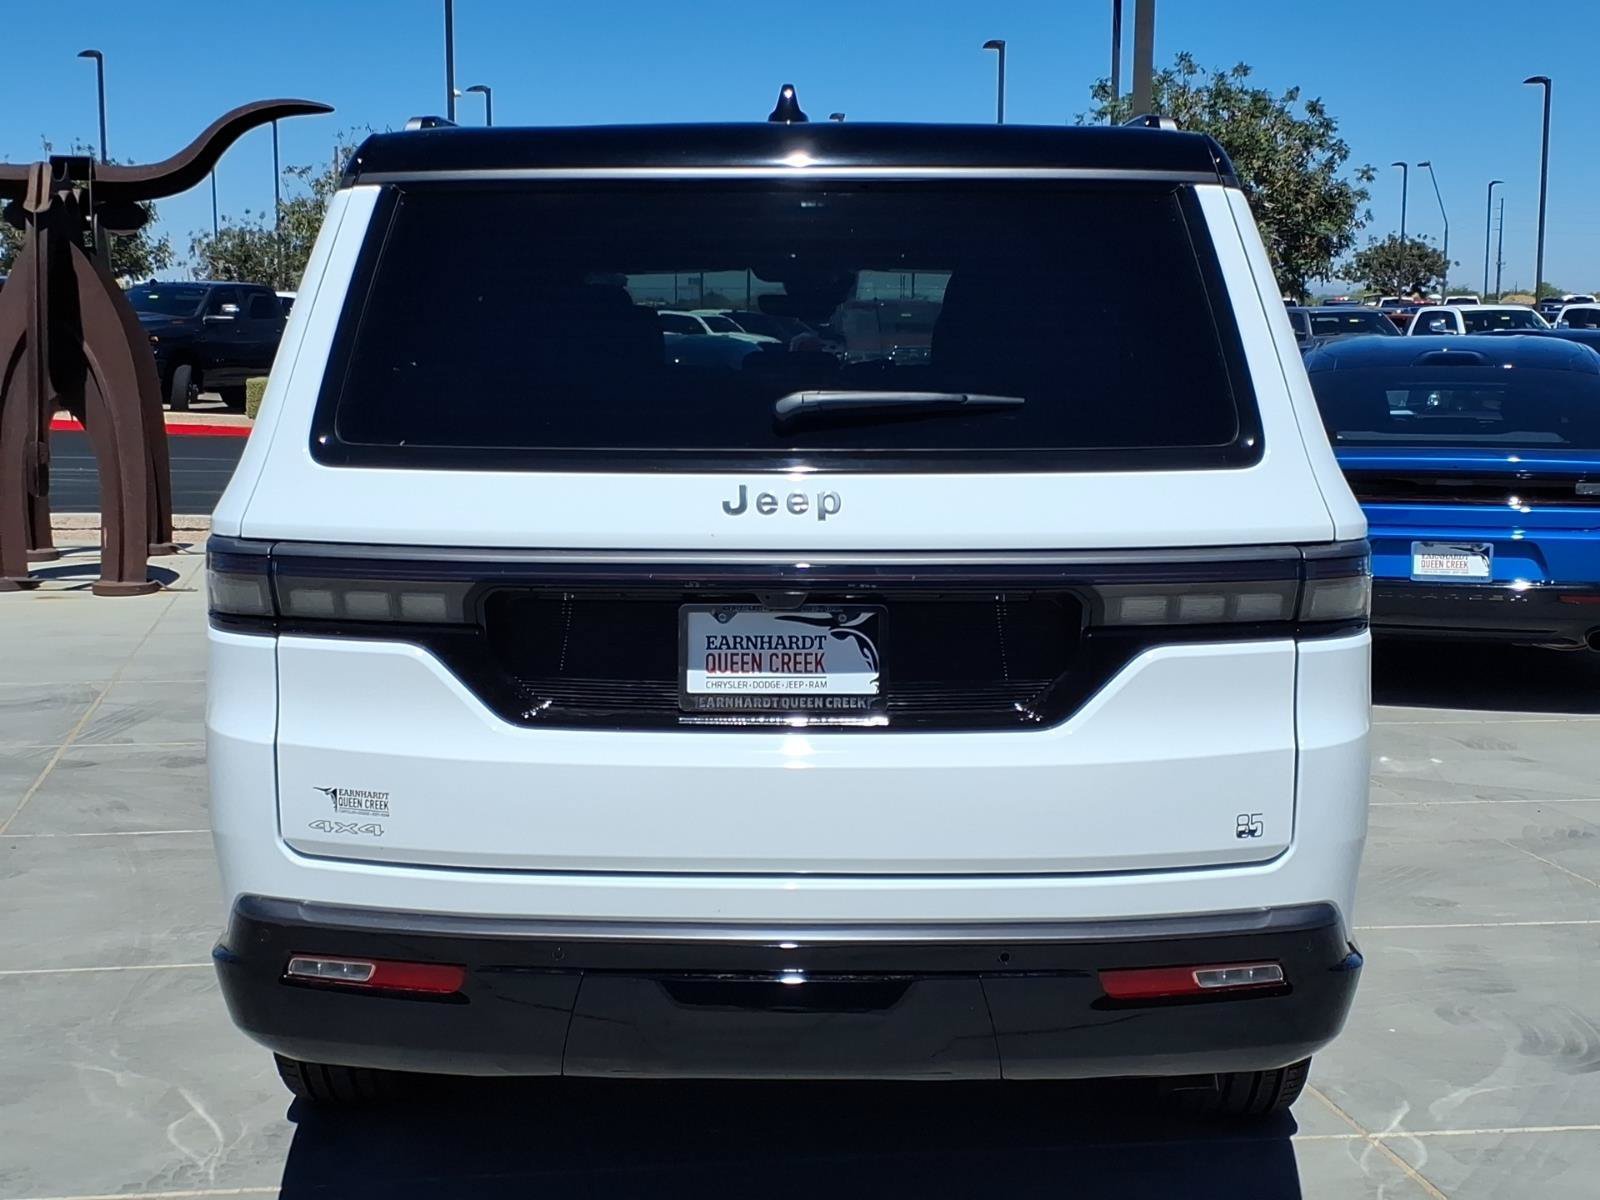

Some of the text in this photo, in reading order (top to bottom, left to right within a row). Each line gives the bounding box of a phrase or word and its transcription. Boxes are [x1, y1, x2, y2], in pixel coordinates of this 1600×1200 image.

[722, 484, 842, 521] Jeep
[705, 635, 827, 650] EARNHARDT
[705, 652, 826, 674] QUEEN CREEK
[698, 697, 869, 709] EARNHARDT QUEEN CREEK
[338, 788, 390, 800] EARNHARDT
[338, 797, 389, 810] QUEEN CREEK
[1236, 812, 1264, 839] 85
